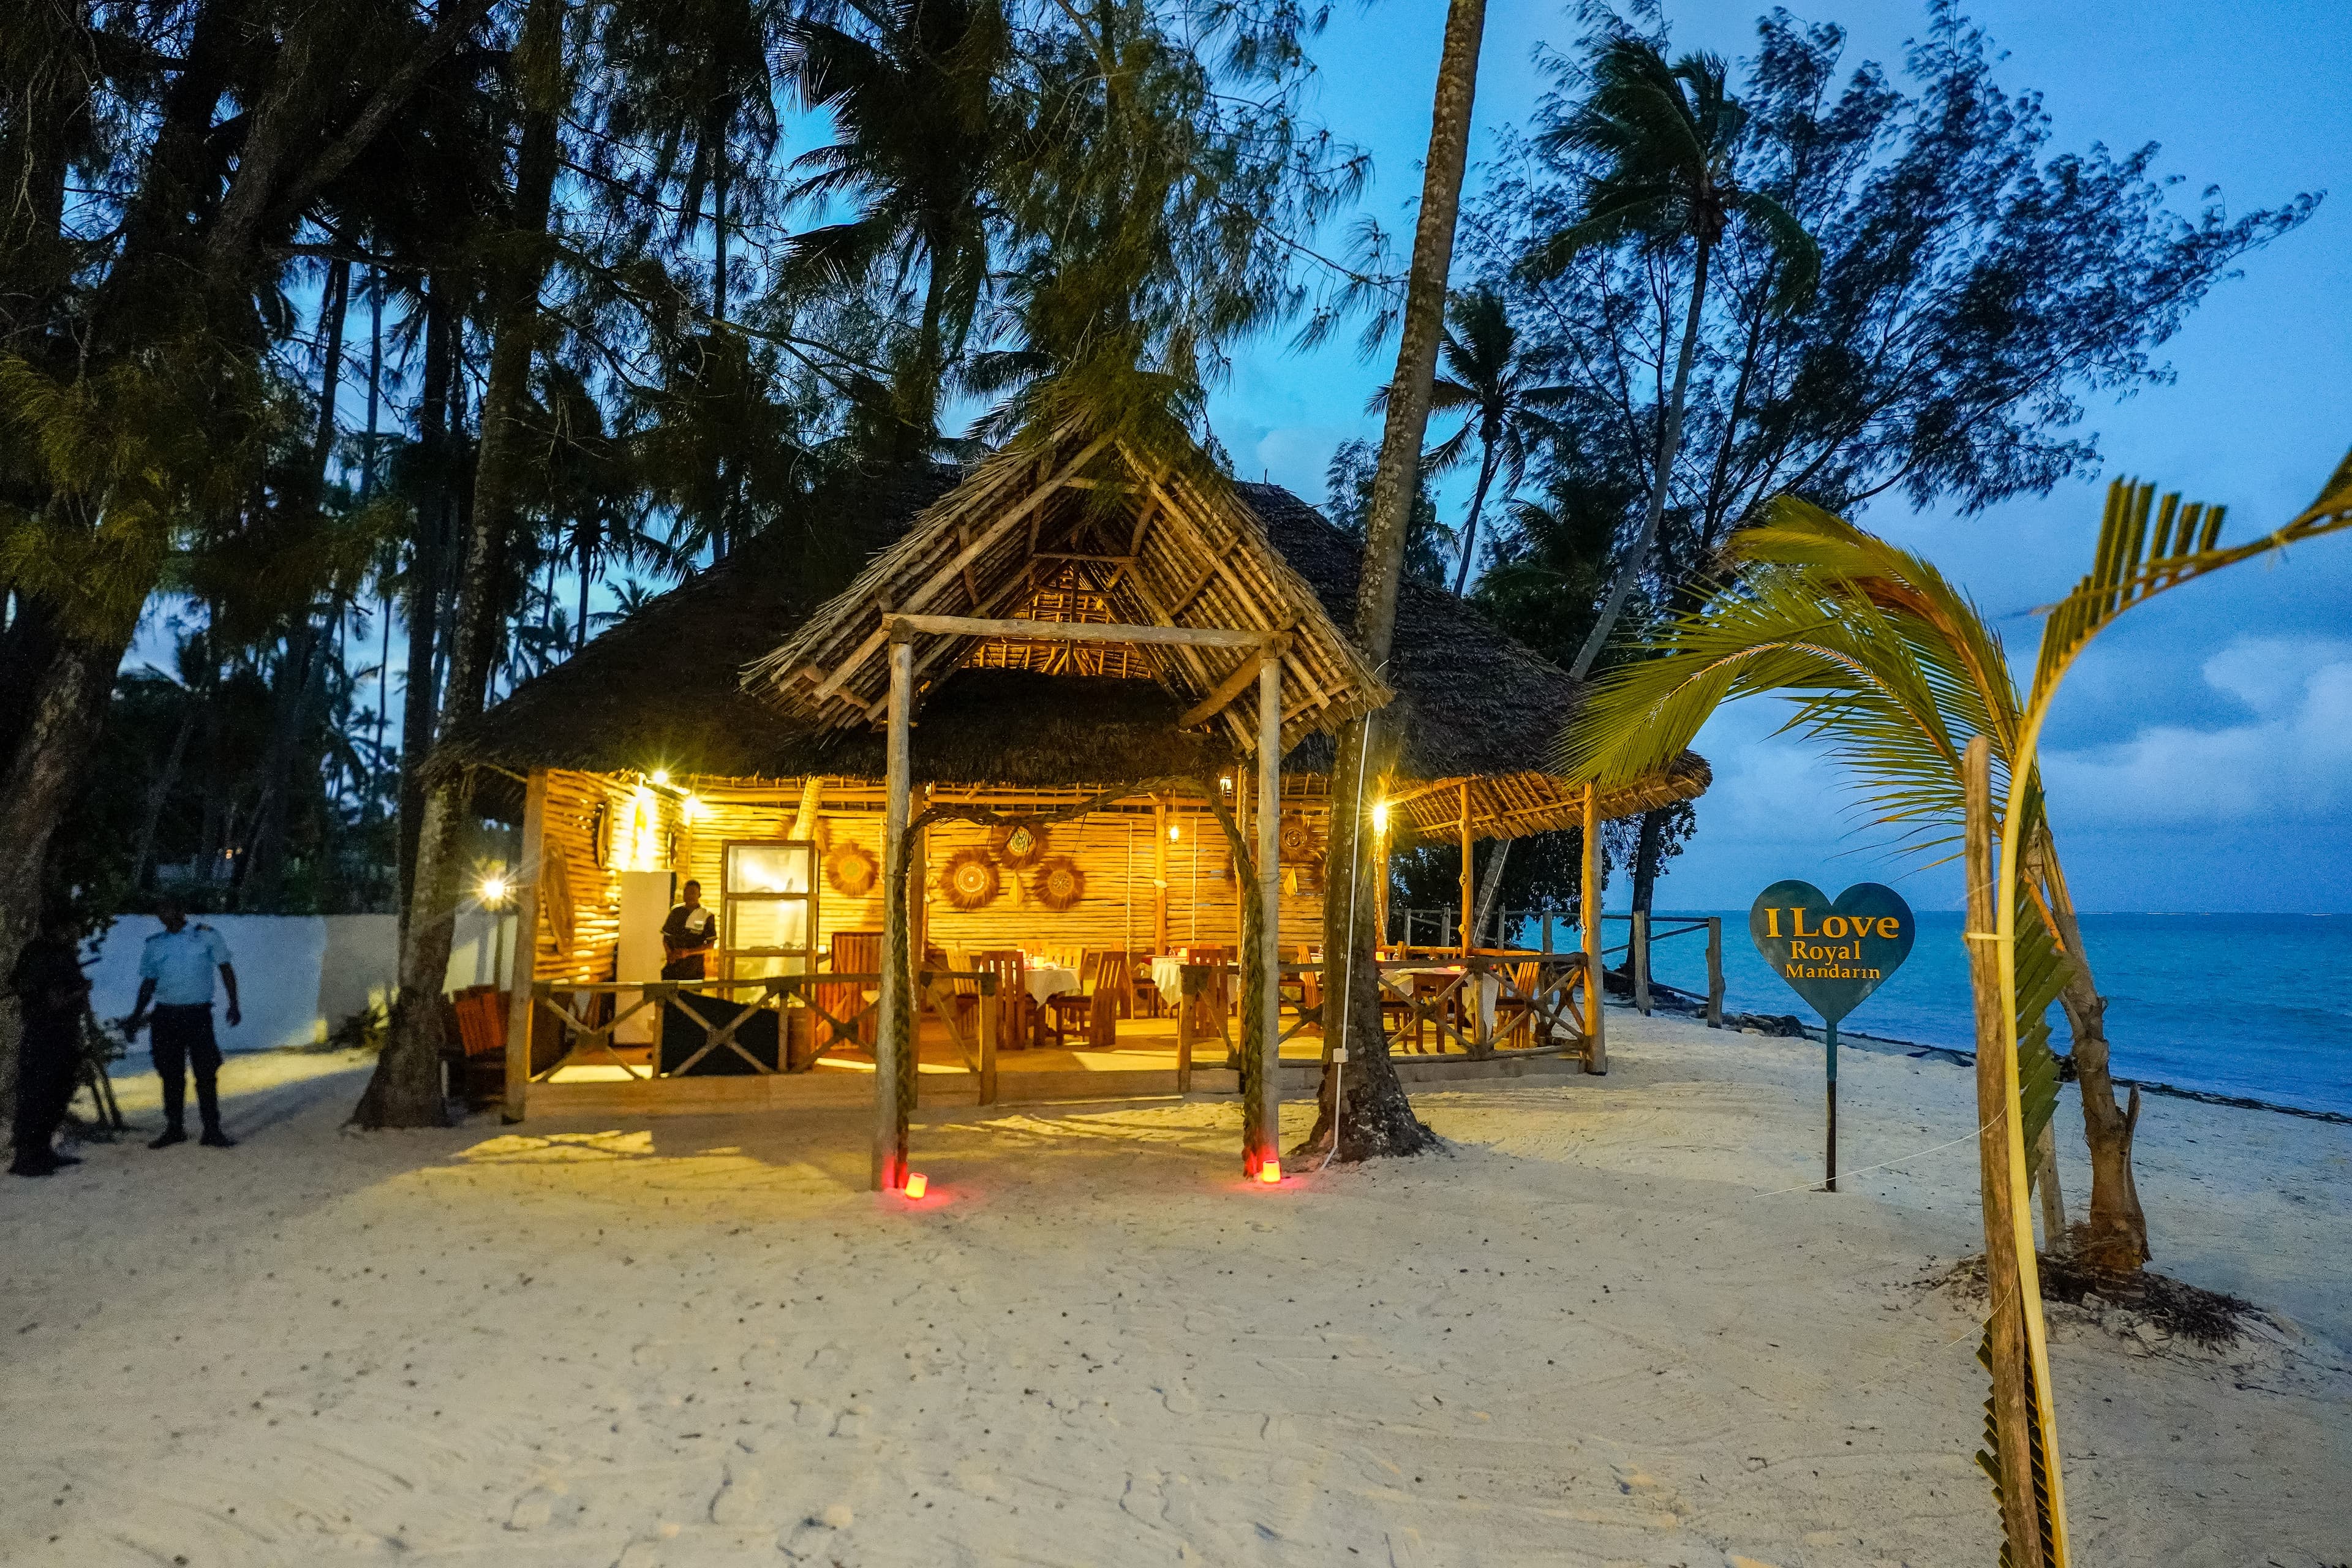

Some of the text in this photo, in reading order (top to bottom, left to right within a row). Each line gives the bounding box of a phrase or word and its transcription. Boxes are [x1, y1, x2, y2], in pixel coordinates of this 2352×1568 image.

[1764, 907, 1900, 938] I Love
[1790, 940, 1861, 966] Royal
[1785, 963, 1880, 979] Mandarin
